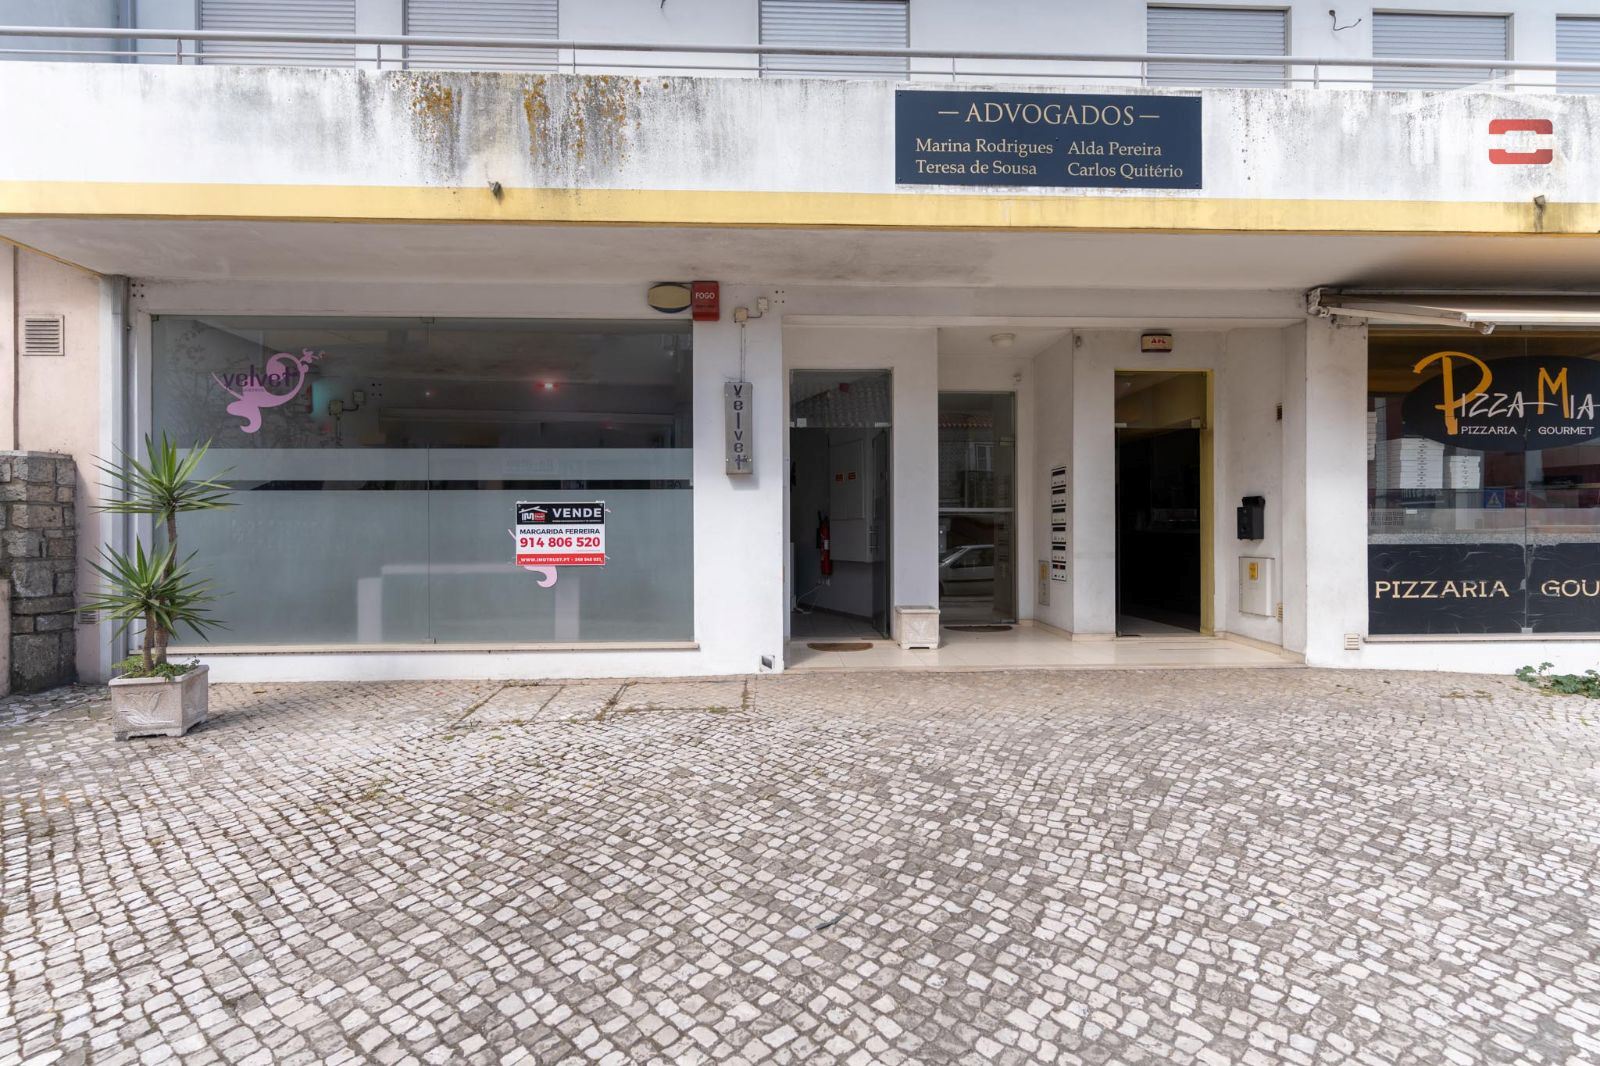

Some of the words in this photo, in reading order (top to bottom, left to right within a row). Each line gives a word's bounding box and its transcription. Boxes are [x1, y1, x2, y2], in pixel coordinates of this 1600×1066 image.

[965, 102, 1134, 126] ADVOGADOS
[915, 138, 970, 154] Marina
[976, 138, 1053, 158] Rodrigues
[1067, 141, 1104, 156] Alda
[1109, 141, 1162, 157] Pereira
[915, 160, 965, 175] Teresa
[970, 160, 989, 175] de
[993, 160, 1037, 176] Sousa
[1067, 162, 1116, 178] Carlos
[1120, 162, 1183, 180] Quitério
[695, 292, 716, 300] FOGO
[223, 364, 298, 387] velvet
[733, 384, 746, 471] velvet
[1461, 425, 1518, 435] PIZZARIA
[1537, 425, 1595, 435] GOURMET
[552, 507, 602, 518] VENDE
[520, 537, 545, 548] 914
[548, 537, 573, 548] 806
[576, 537, 601, 548] 520
[1374, 580, 1510, 599] PIZZARIA
